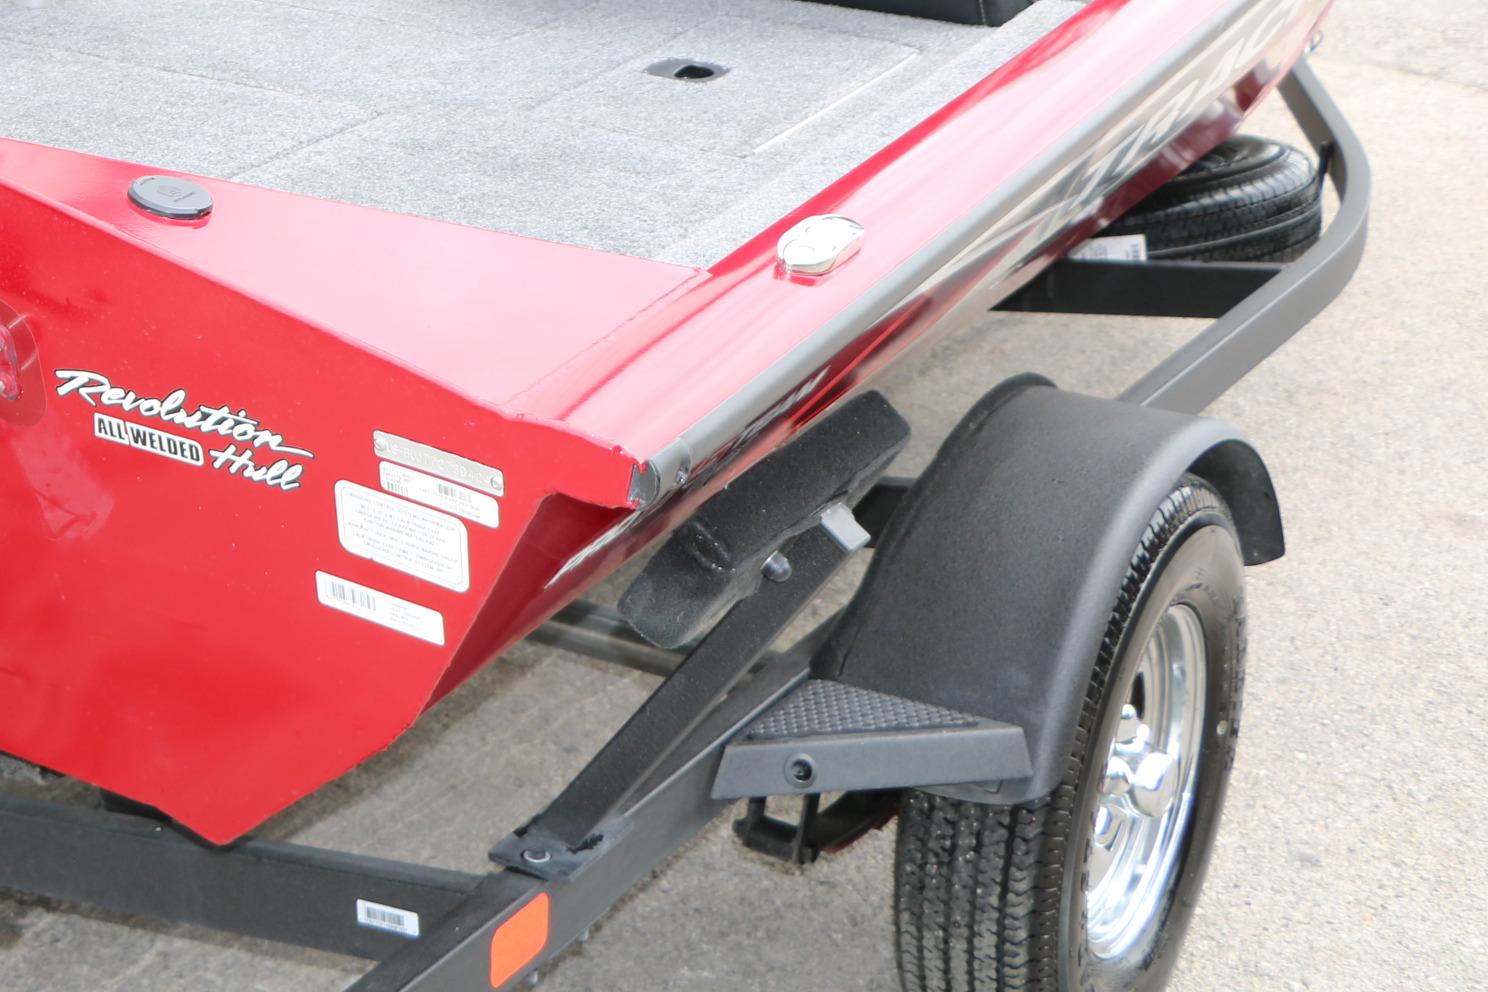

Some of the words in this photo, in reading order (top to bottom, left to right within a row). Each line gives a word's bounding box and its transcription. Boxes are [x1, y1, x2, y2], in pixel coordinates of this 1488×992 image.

[54, 368, 315, 459] Revolution
[97, 417, 127, 440] ALL
[129, 425, 200, 462] WELDED
[209, 443, 304, 491] Hull
